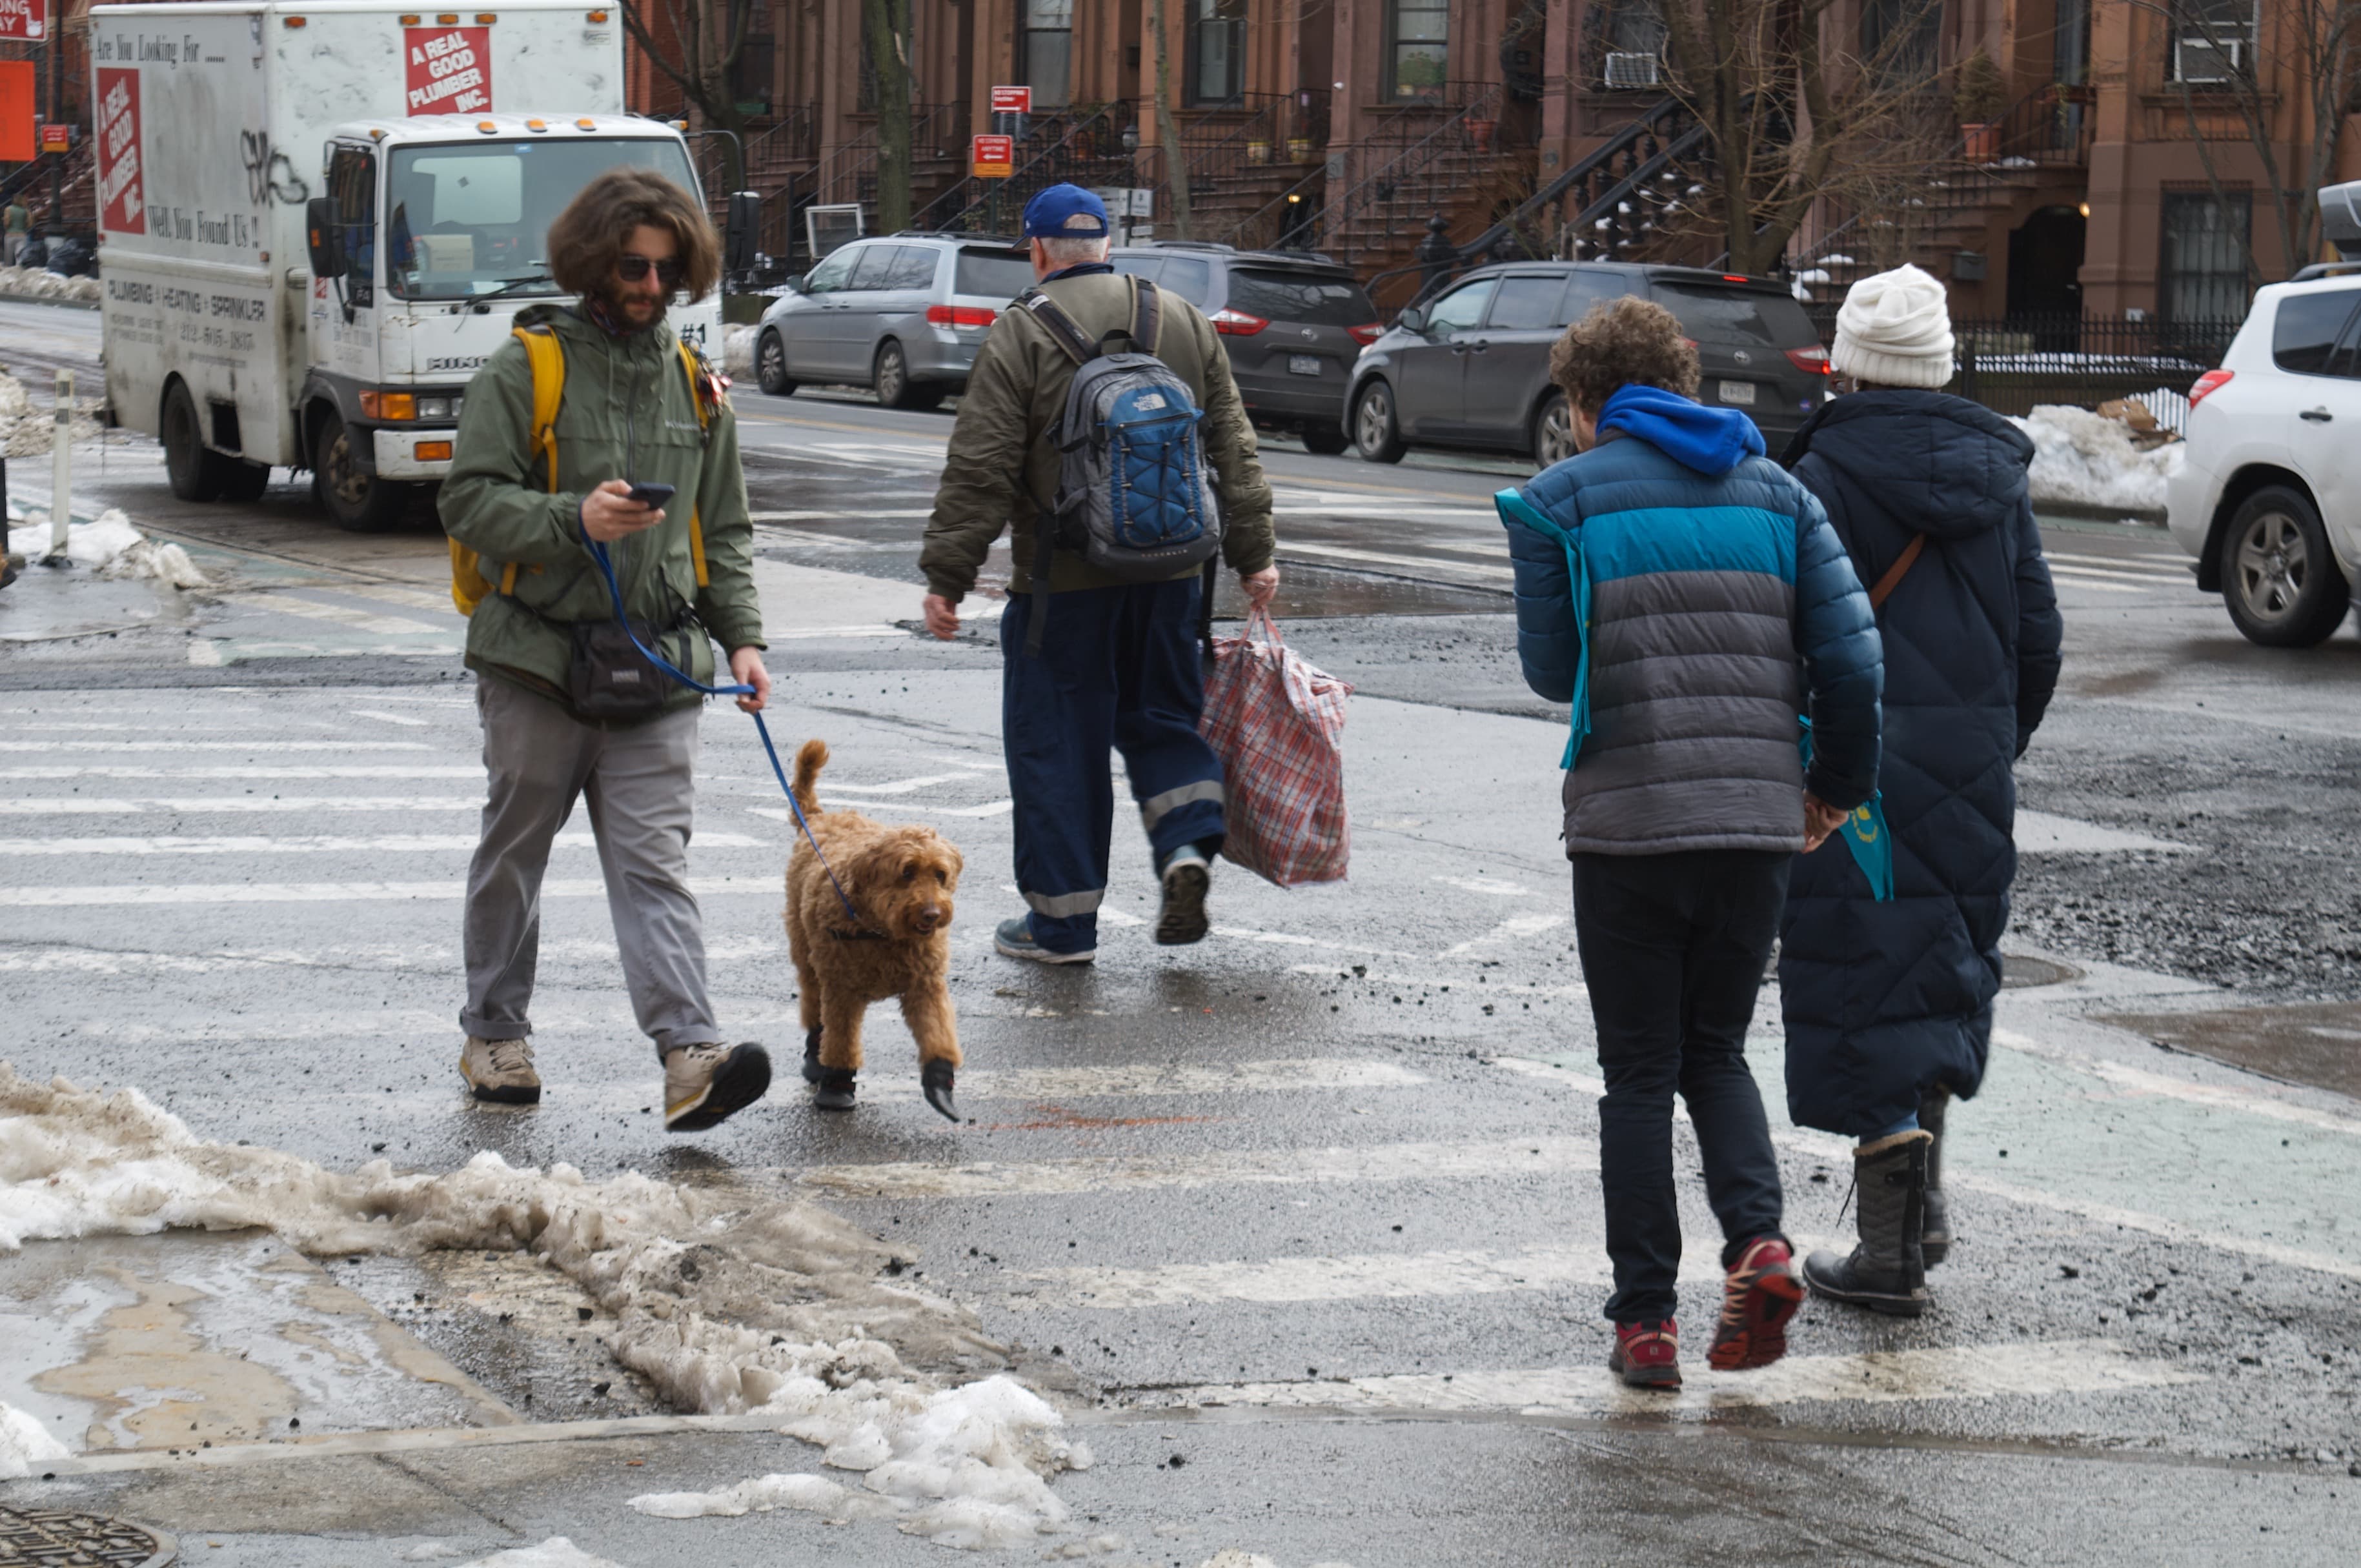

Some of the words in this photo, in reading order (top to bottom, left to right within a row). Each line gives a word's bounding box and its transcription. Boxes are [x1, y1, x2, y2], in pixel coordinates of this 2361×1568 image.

[96, 35, 114, 61] Are
[116, 34, 133, 61] You
[137, 34, 177, 70] Looking
[183, 34, 200, 63] For
[412, 46, 426, 66] A
[423, 31, 469, 59] REAL
[429, 48, 476, 79] GOOD
[105, 76, 131, 126] REAL
[408, 67, 484, 108] PLUMBER
[454, 88, 489, 113] INC.
[108, 109, 134, 161] GOOD
[99, 144, 139, 212] PLUMBER
[174, 207, 192, 241] You
[196, 210, 228, 245] Found
[233, 214, 248, 248] Us
[108, 280, 152, 305] PLUMBING
[163, 287, 201, 314] HEATING
[210, 295, 265, 322] SPRINKLER
